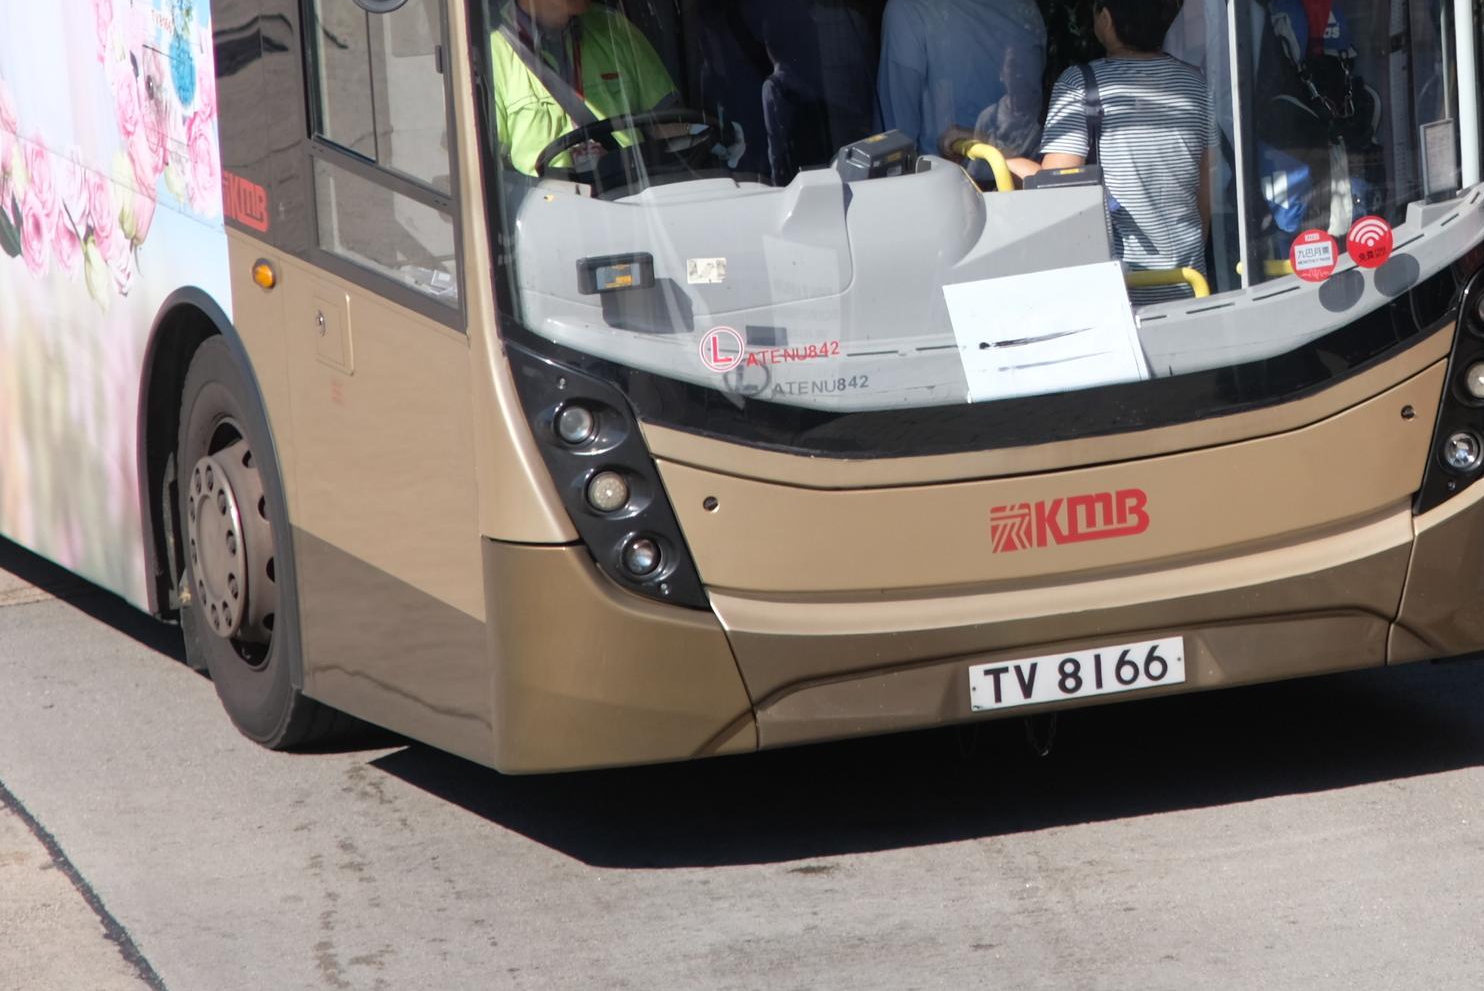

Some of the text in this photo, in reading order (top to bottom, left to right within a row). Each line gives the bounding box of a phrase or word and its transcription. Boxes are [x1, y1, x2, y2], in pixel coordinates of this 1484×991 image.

[229, 172, 269, 233] KMB
[746, 340, 841, 368] ATENU842
[1034, 488, 1151, 548] KMB
[983, 645, 1169, 704] TV 8166
